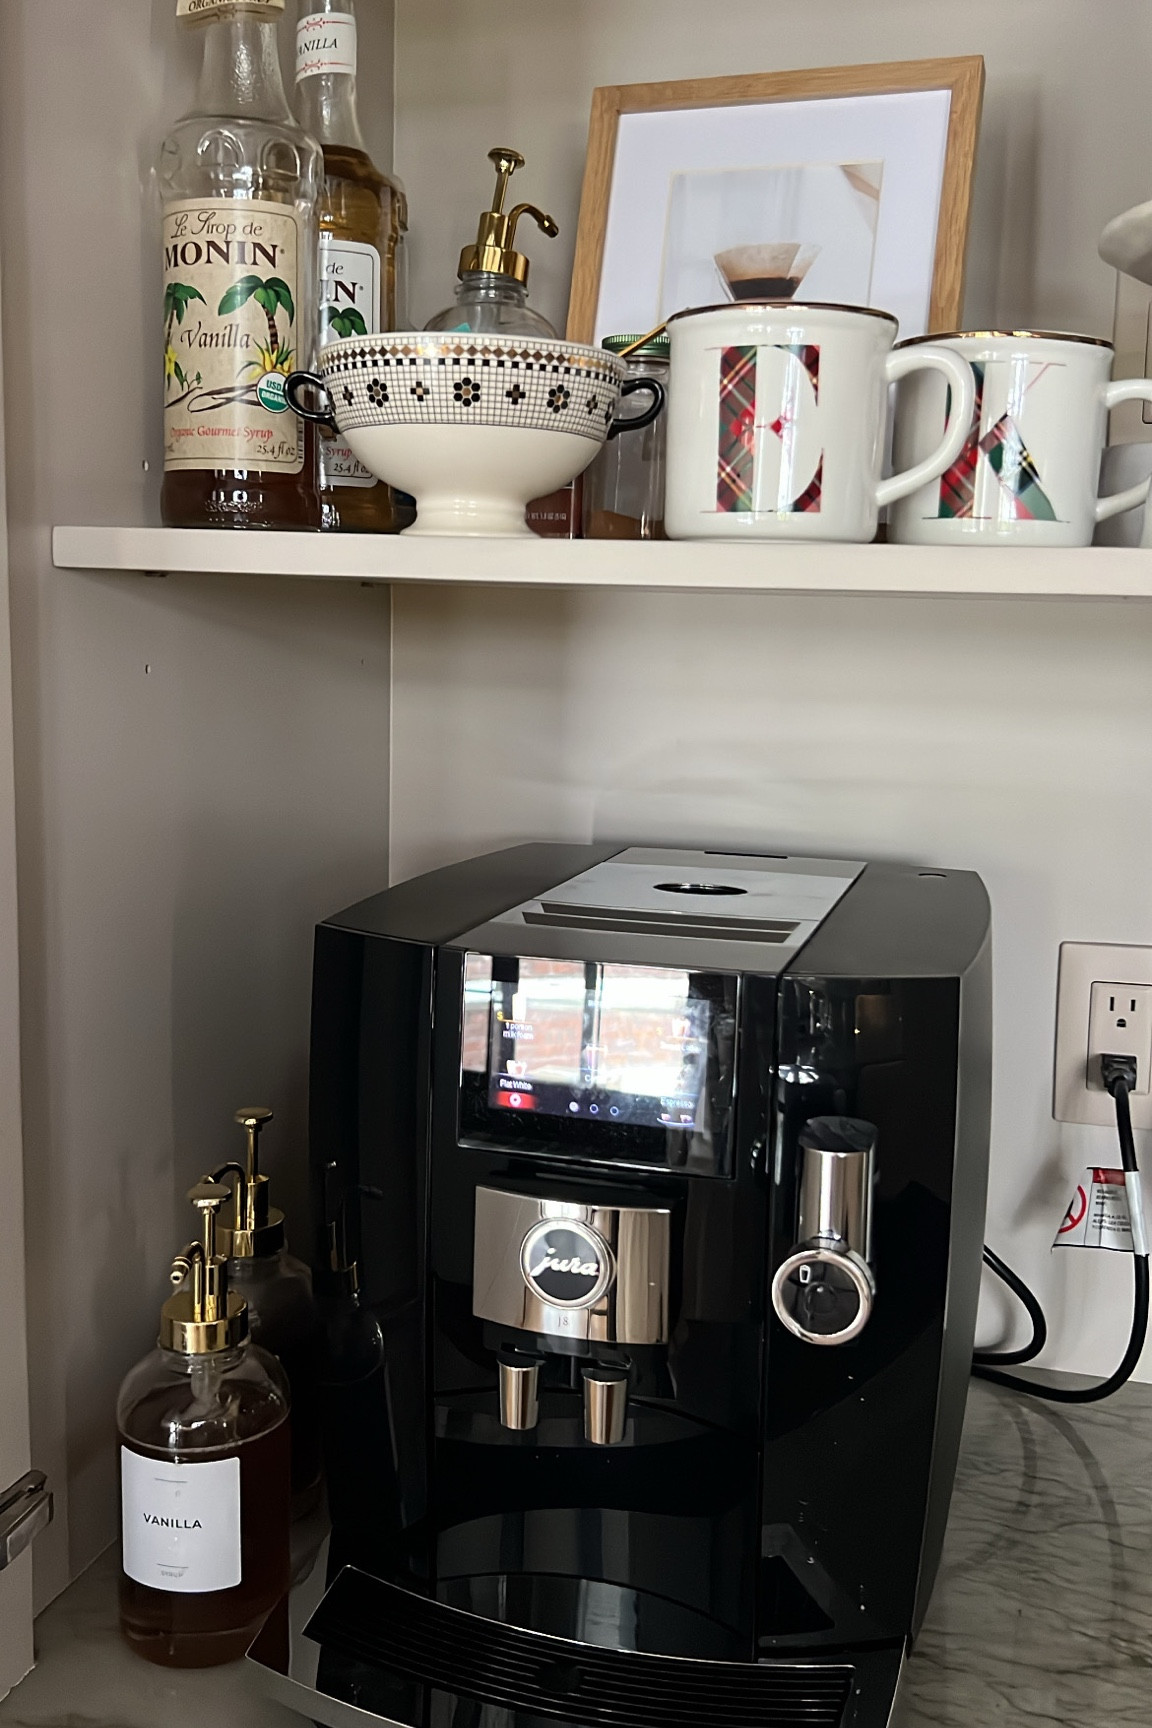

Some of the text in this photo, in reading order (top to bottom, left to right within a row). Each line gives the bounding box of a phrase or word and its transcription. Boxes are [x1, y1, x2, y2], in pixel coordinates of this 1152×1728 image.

[171, 211, 263, 240] Le Sirop de
[165, 240, 278, 271] MONIN
[326, 262, 344, 275] de
[181, 320, 251, 349] Vanilla
[266, 380, 282, 391] USD
[197, 426, 240, 437] Gourmet
[243, 427, 273, 443] Syrup
[700, 345, 823, 513] E
[257, 444, 275, 456] 25.4
[326, 446, 353, 461] Syrup
[333, 463, 351, 474] 25.4
[528, 1247, 600, 1277] jura
[143, 1512, 202, 1529] VANILLA
